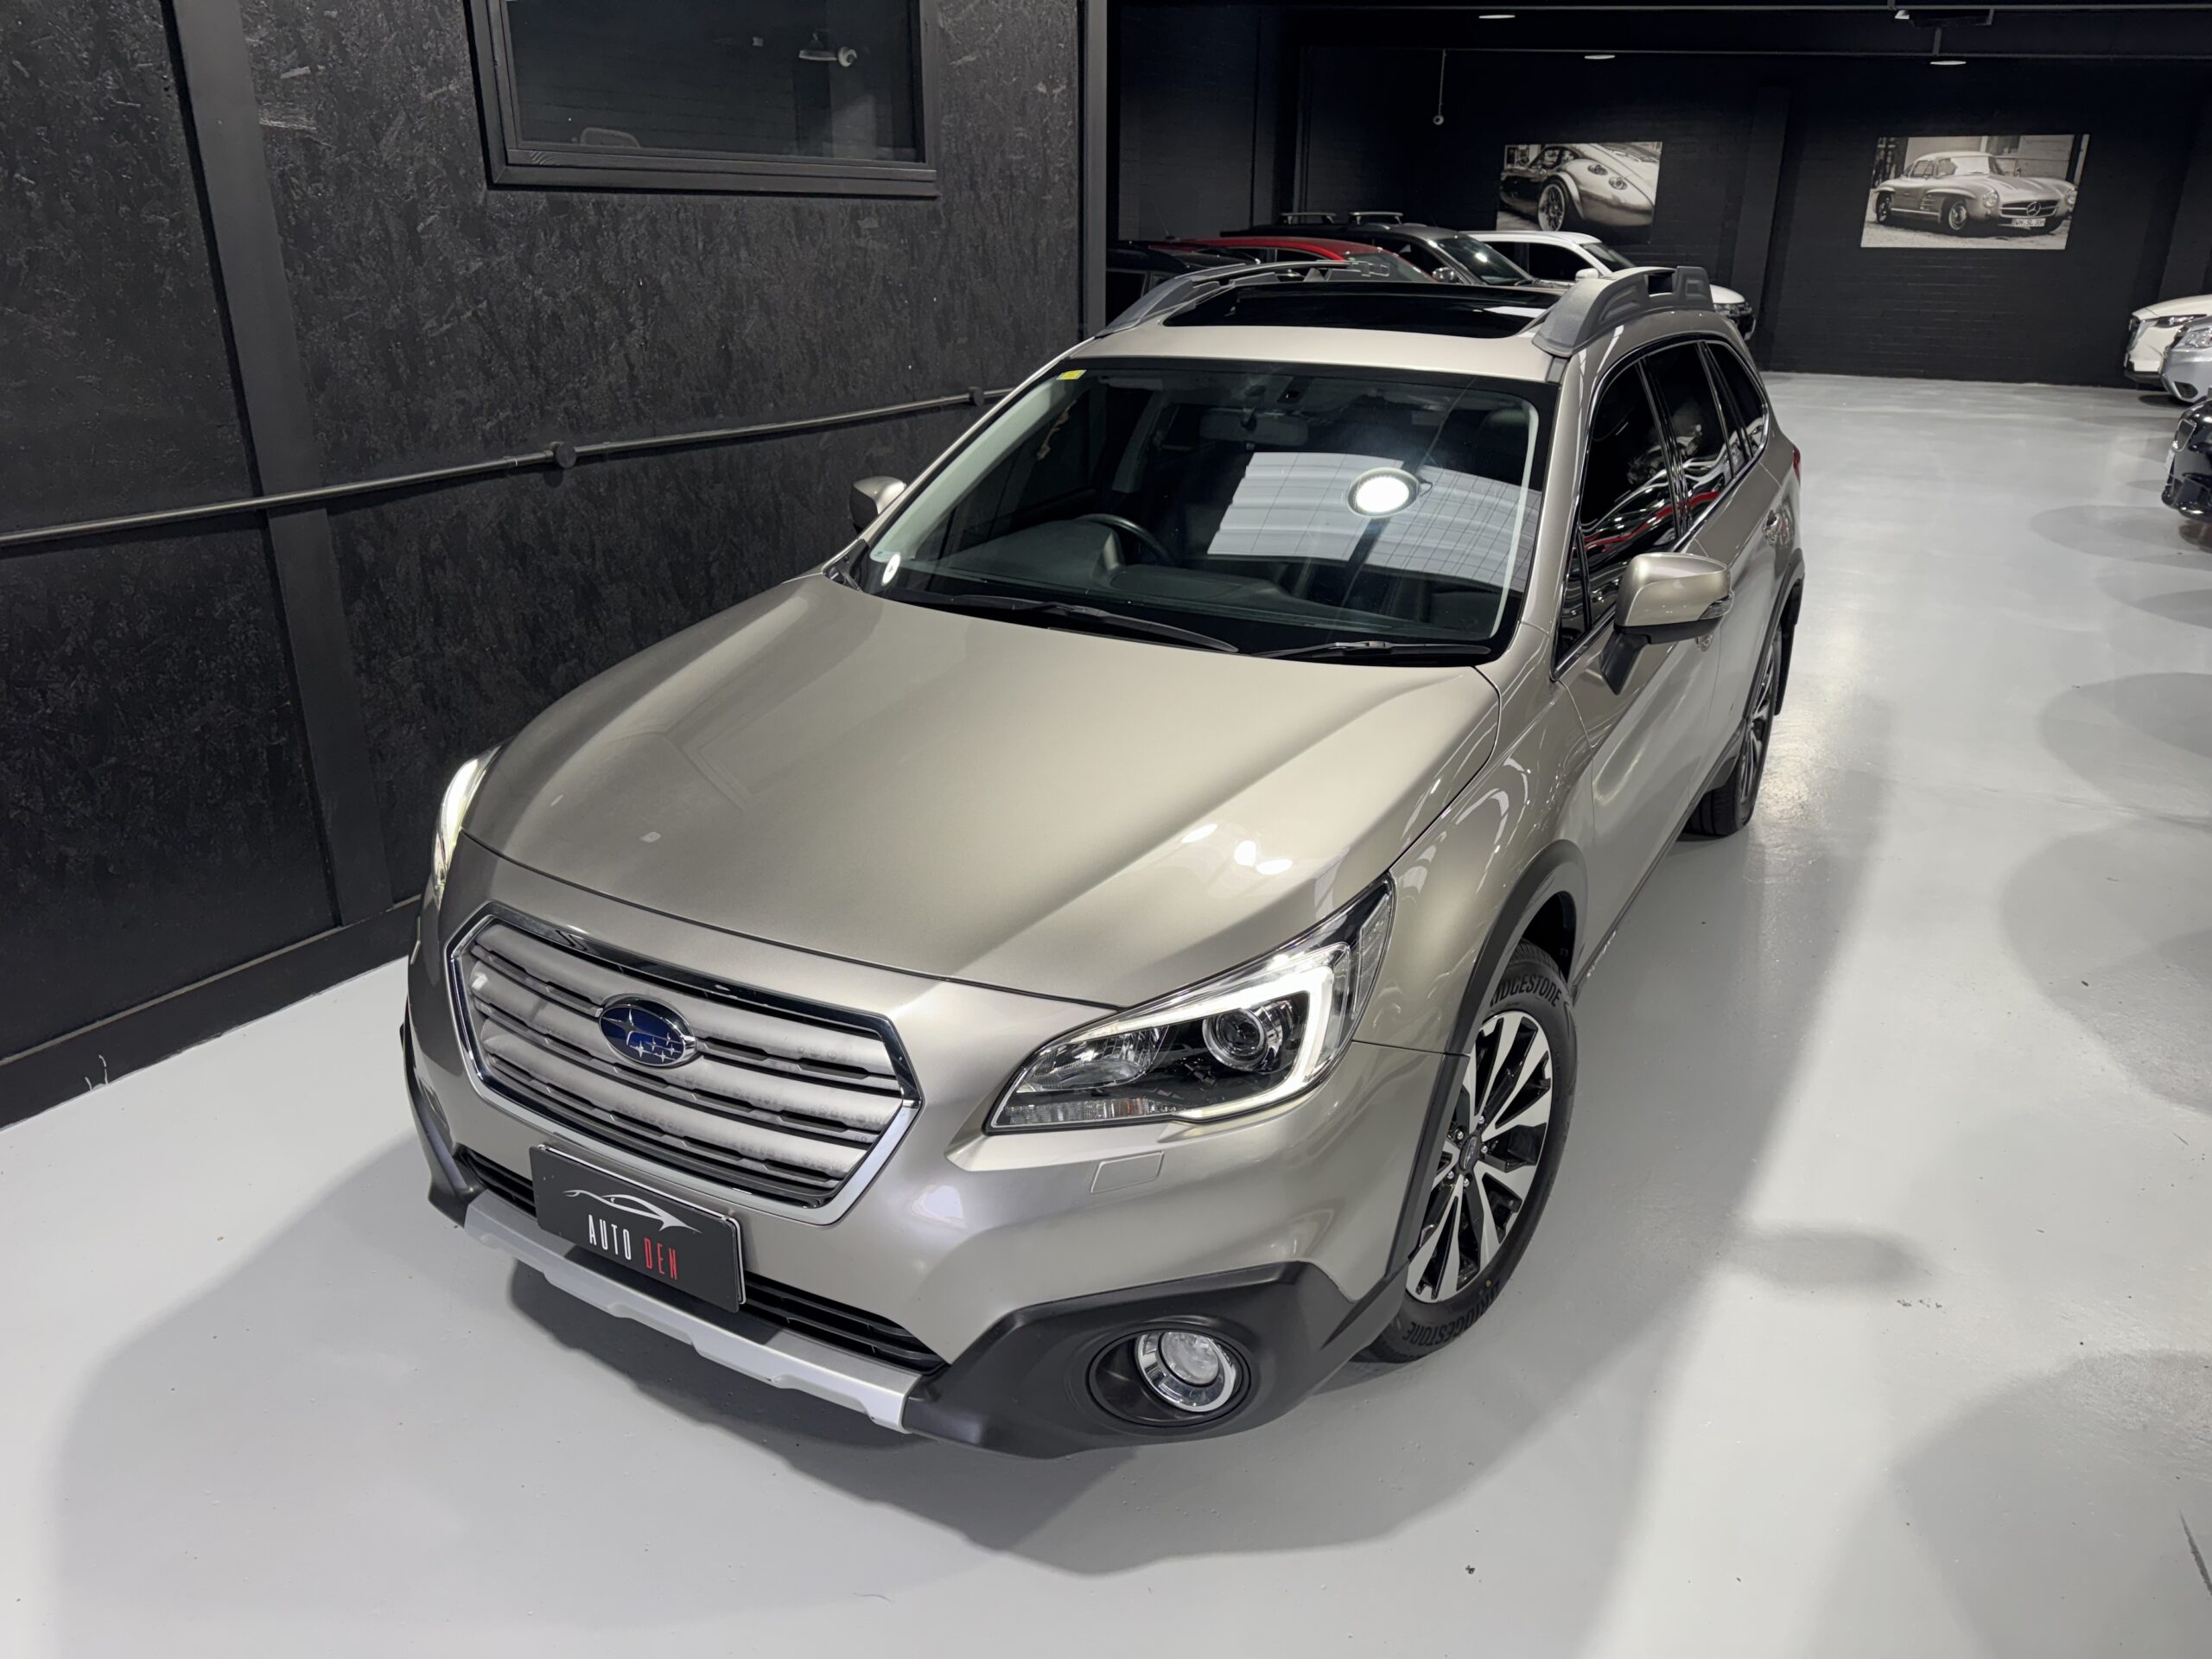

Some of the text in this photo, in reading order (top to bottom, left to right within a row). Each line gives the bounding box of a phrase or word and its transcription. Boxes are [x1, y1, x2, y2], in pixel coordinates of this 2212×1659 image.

[1491, 974, 1562, 1007] IDGESTONE
[588, 1214, 677, 1280] AUTO DEN
